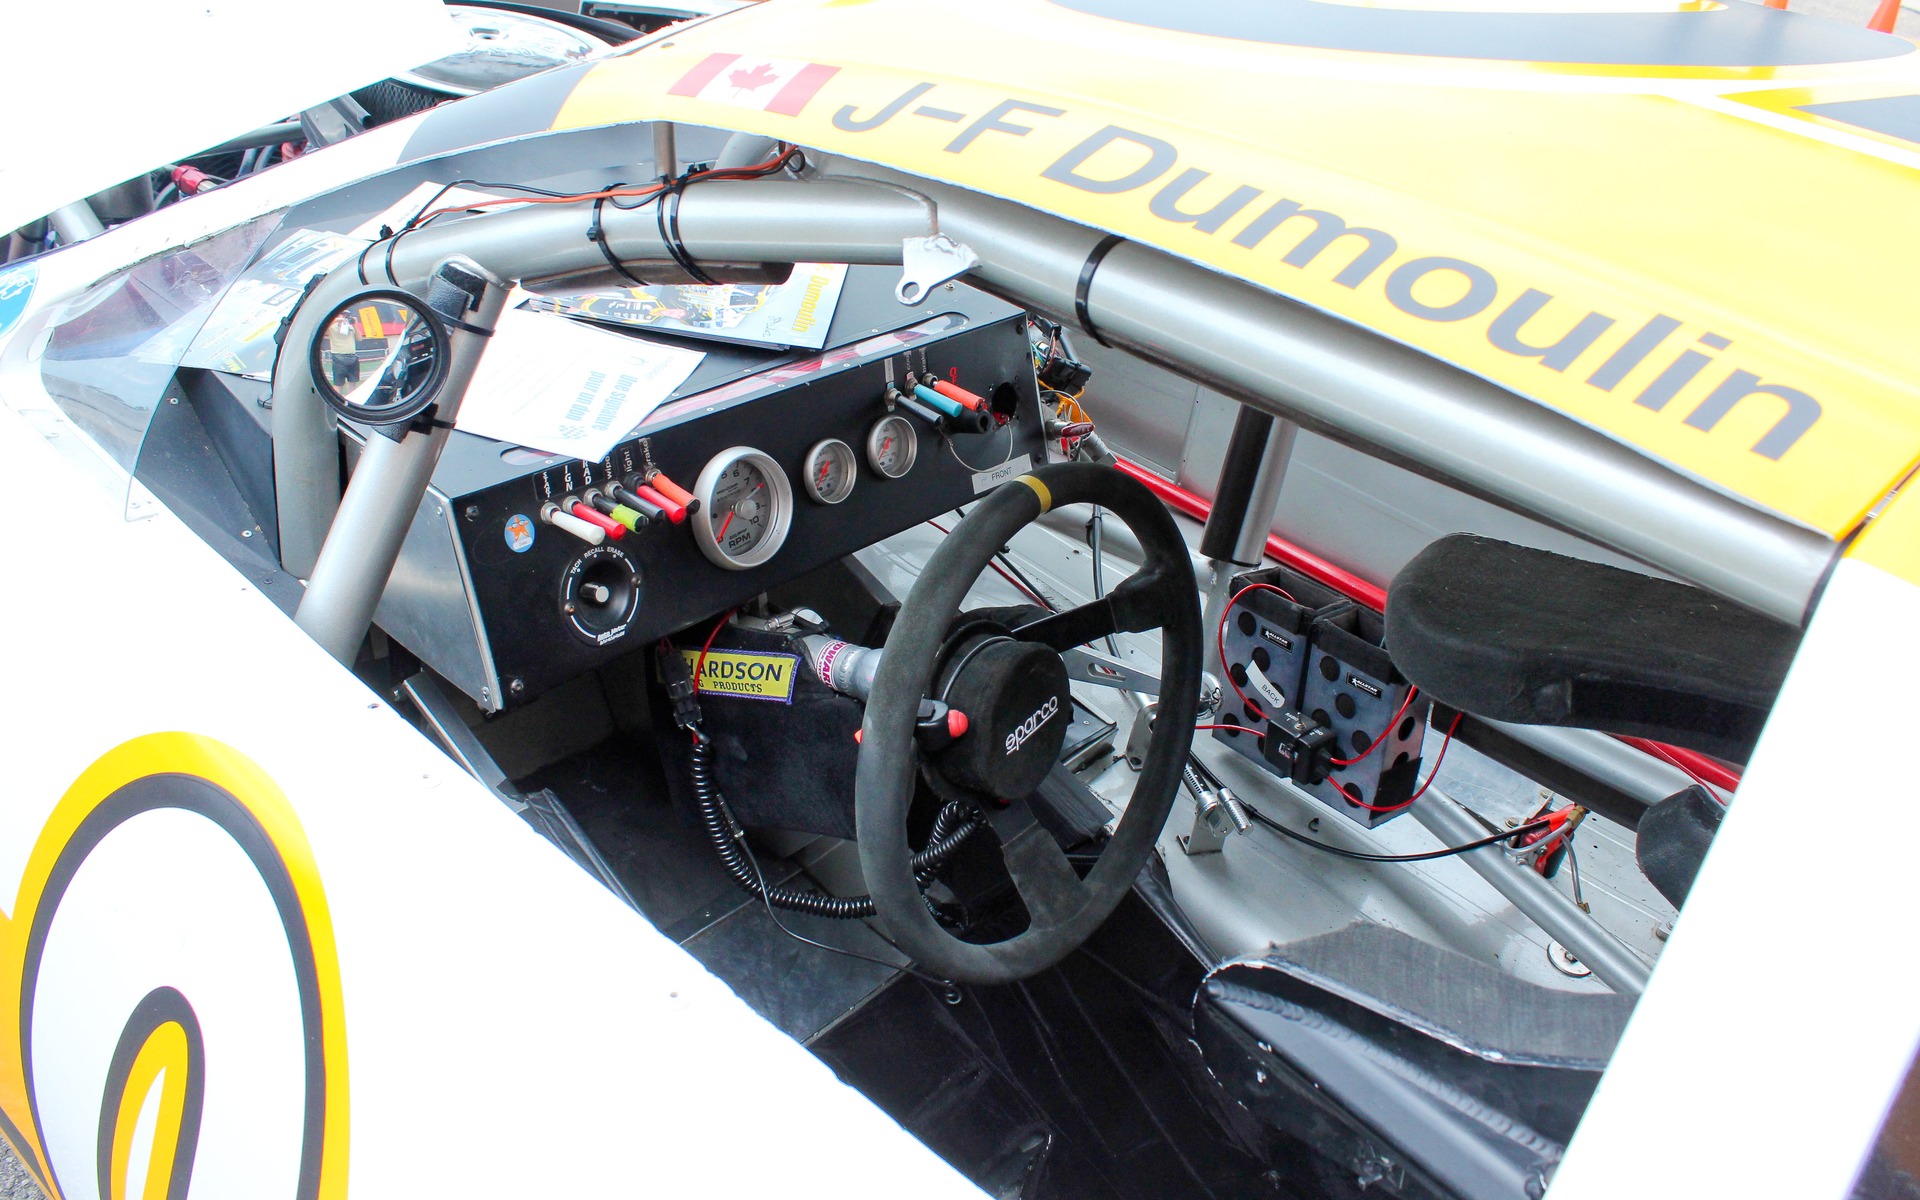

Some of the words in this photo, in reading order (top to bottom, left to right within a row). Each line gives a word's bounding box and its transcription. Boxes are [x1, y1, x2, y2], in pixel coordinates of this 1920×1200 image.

[831, 82, 1067, 154] J-F
[1040, 124, 1823, 462] Dumoulin
[791, 274, 830, 333] Dumoulin
[583, 370, 607, 393] pour
[614, 374, 639, 392] Une
[576, 392, 595, 405] un
[565, 403, 590, 421] don
[591, 391, 627, 431] signature
[624, 450, 633, 473] light
[564, 464, 573, 491] IGN
[583, 460, 592, 486] RAD
[733, 469, 740, 478] 6
[744, 476, 750, 485] 7
[991, 467, 1012, 481] FRONT
[749, 515, 760, 526] 10
[728, 532, 751, 548] RPM
[570, 558, 582, 574] TACH
[583, 546, 604, 558] RECALL
[607, 546, 625, 558] ERASE
[823, 641, 848, 688] DWAR
[713, 681, 763, 693] PRODUCTS
[1261, 684, 1280, 704] BACK
[1005, 695, 1058, 752] sparco
